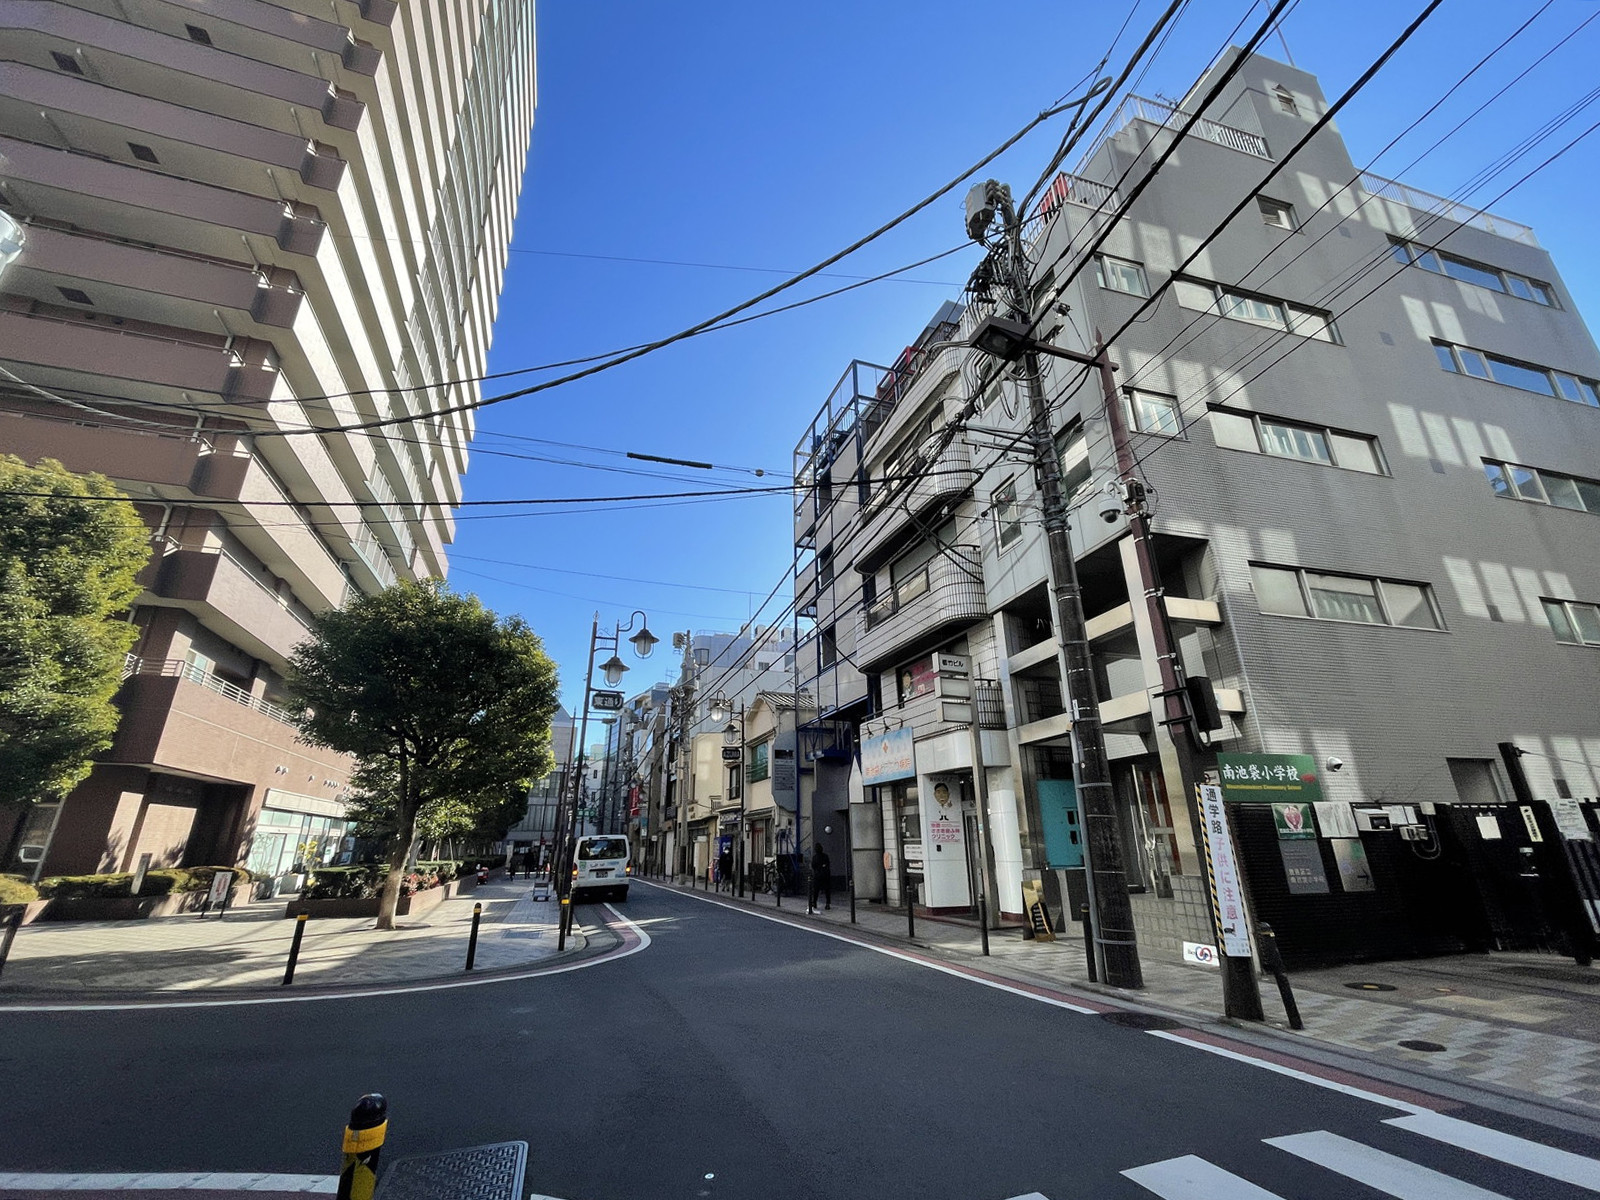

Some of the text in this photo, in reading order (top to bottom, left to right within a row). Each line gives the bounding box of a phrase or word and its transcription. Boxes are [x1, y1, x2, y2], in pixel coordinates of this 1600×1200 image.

[593, 696, 623, 708] 東通り
[1222, 763, 1300, 781] 南池袋小学校
